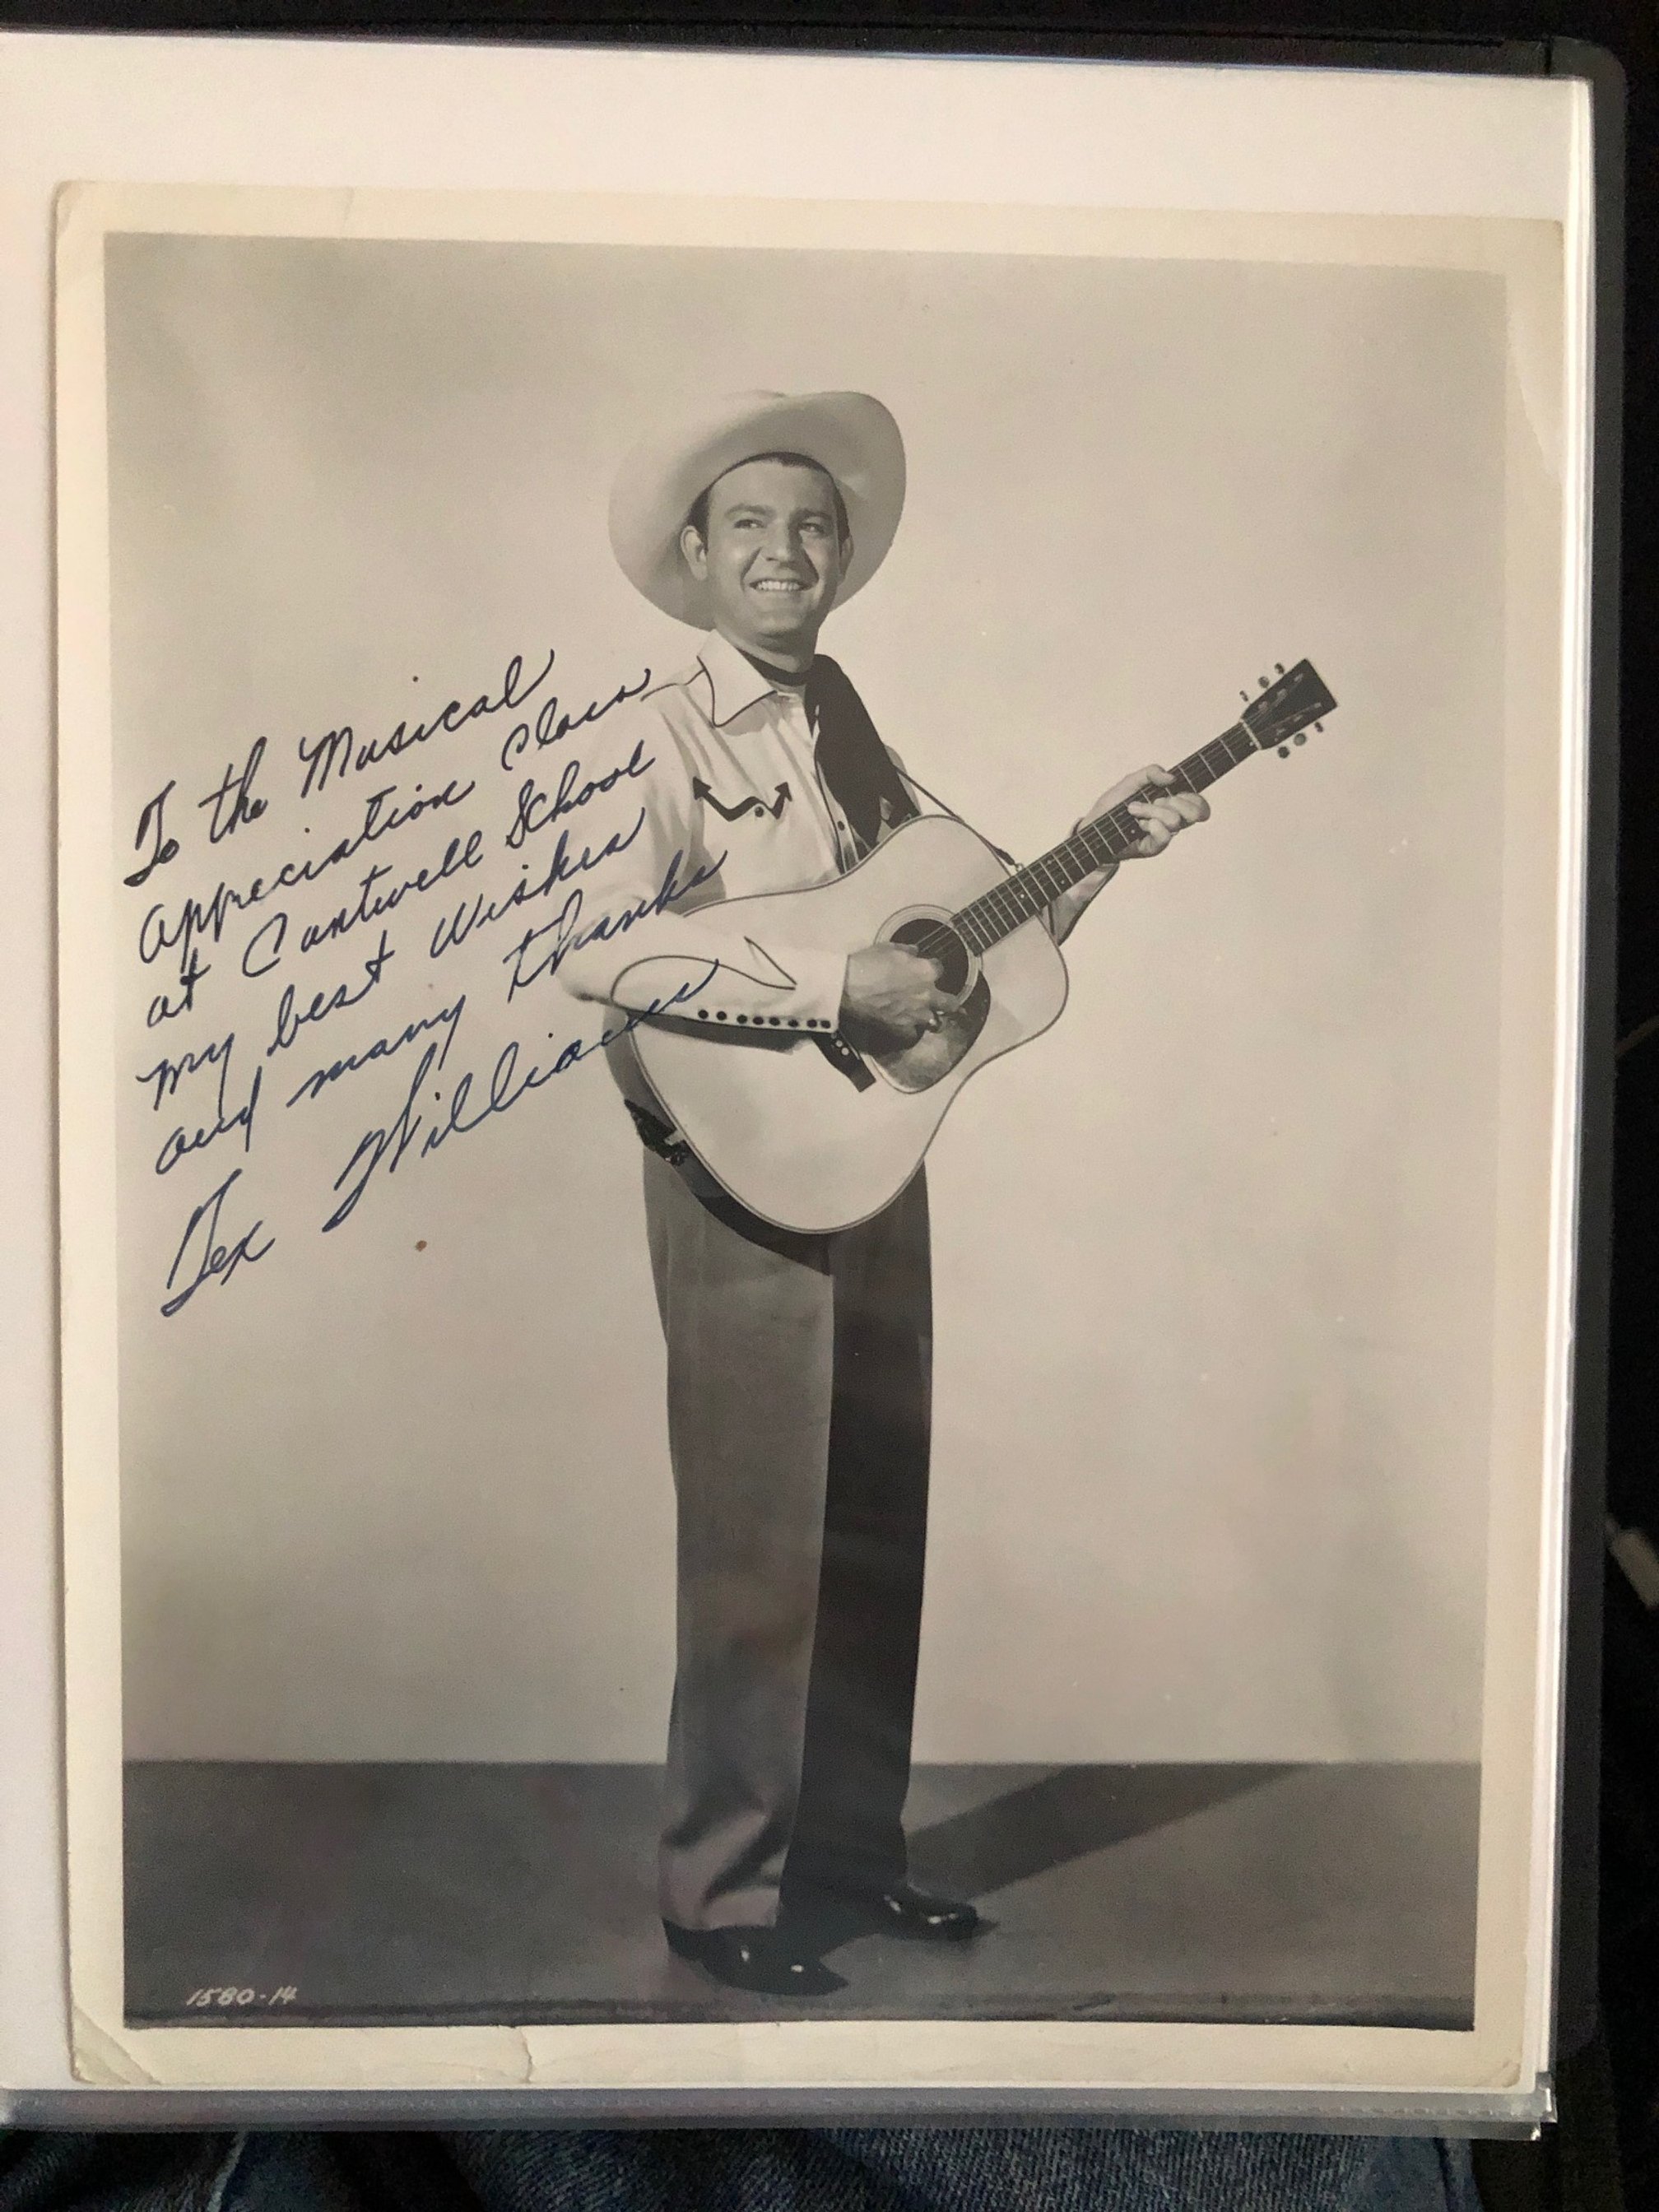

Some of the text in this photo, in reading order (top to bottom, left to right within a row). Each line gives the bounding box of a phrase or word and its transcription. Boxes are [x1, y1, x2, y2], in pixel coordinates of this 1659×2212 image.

[123, 648, 555, 887] To the Musical
[146, 948, 212, 1029] at
[505, 740, 657, 849] School
[155, 849, 728, 1175] and many thanks
[267, 930, 396, 1057] best
[160, 958, 721, 1317] Tex Williams
[185, 1985, 298, 2007] 1580-14
